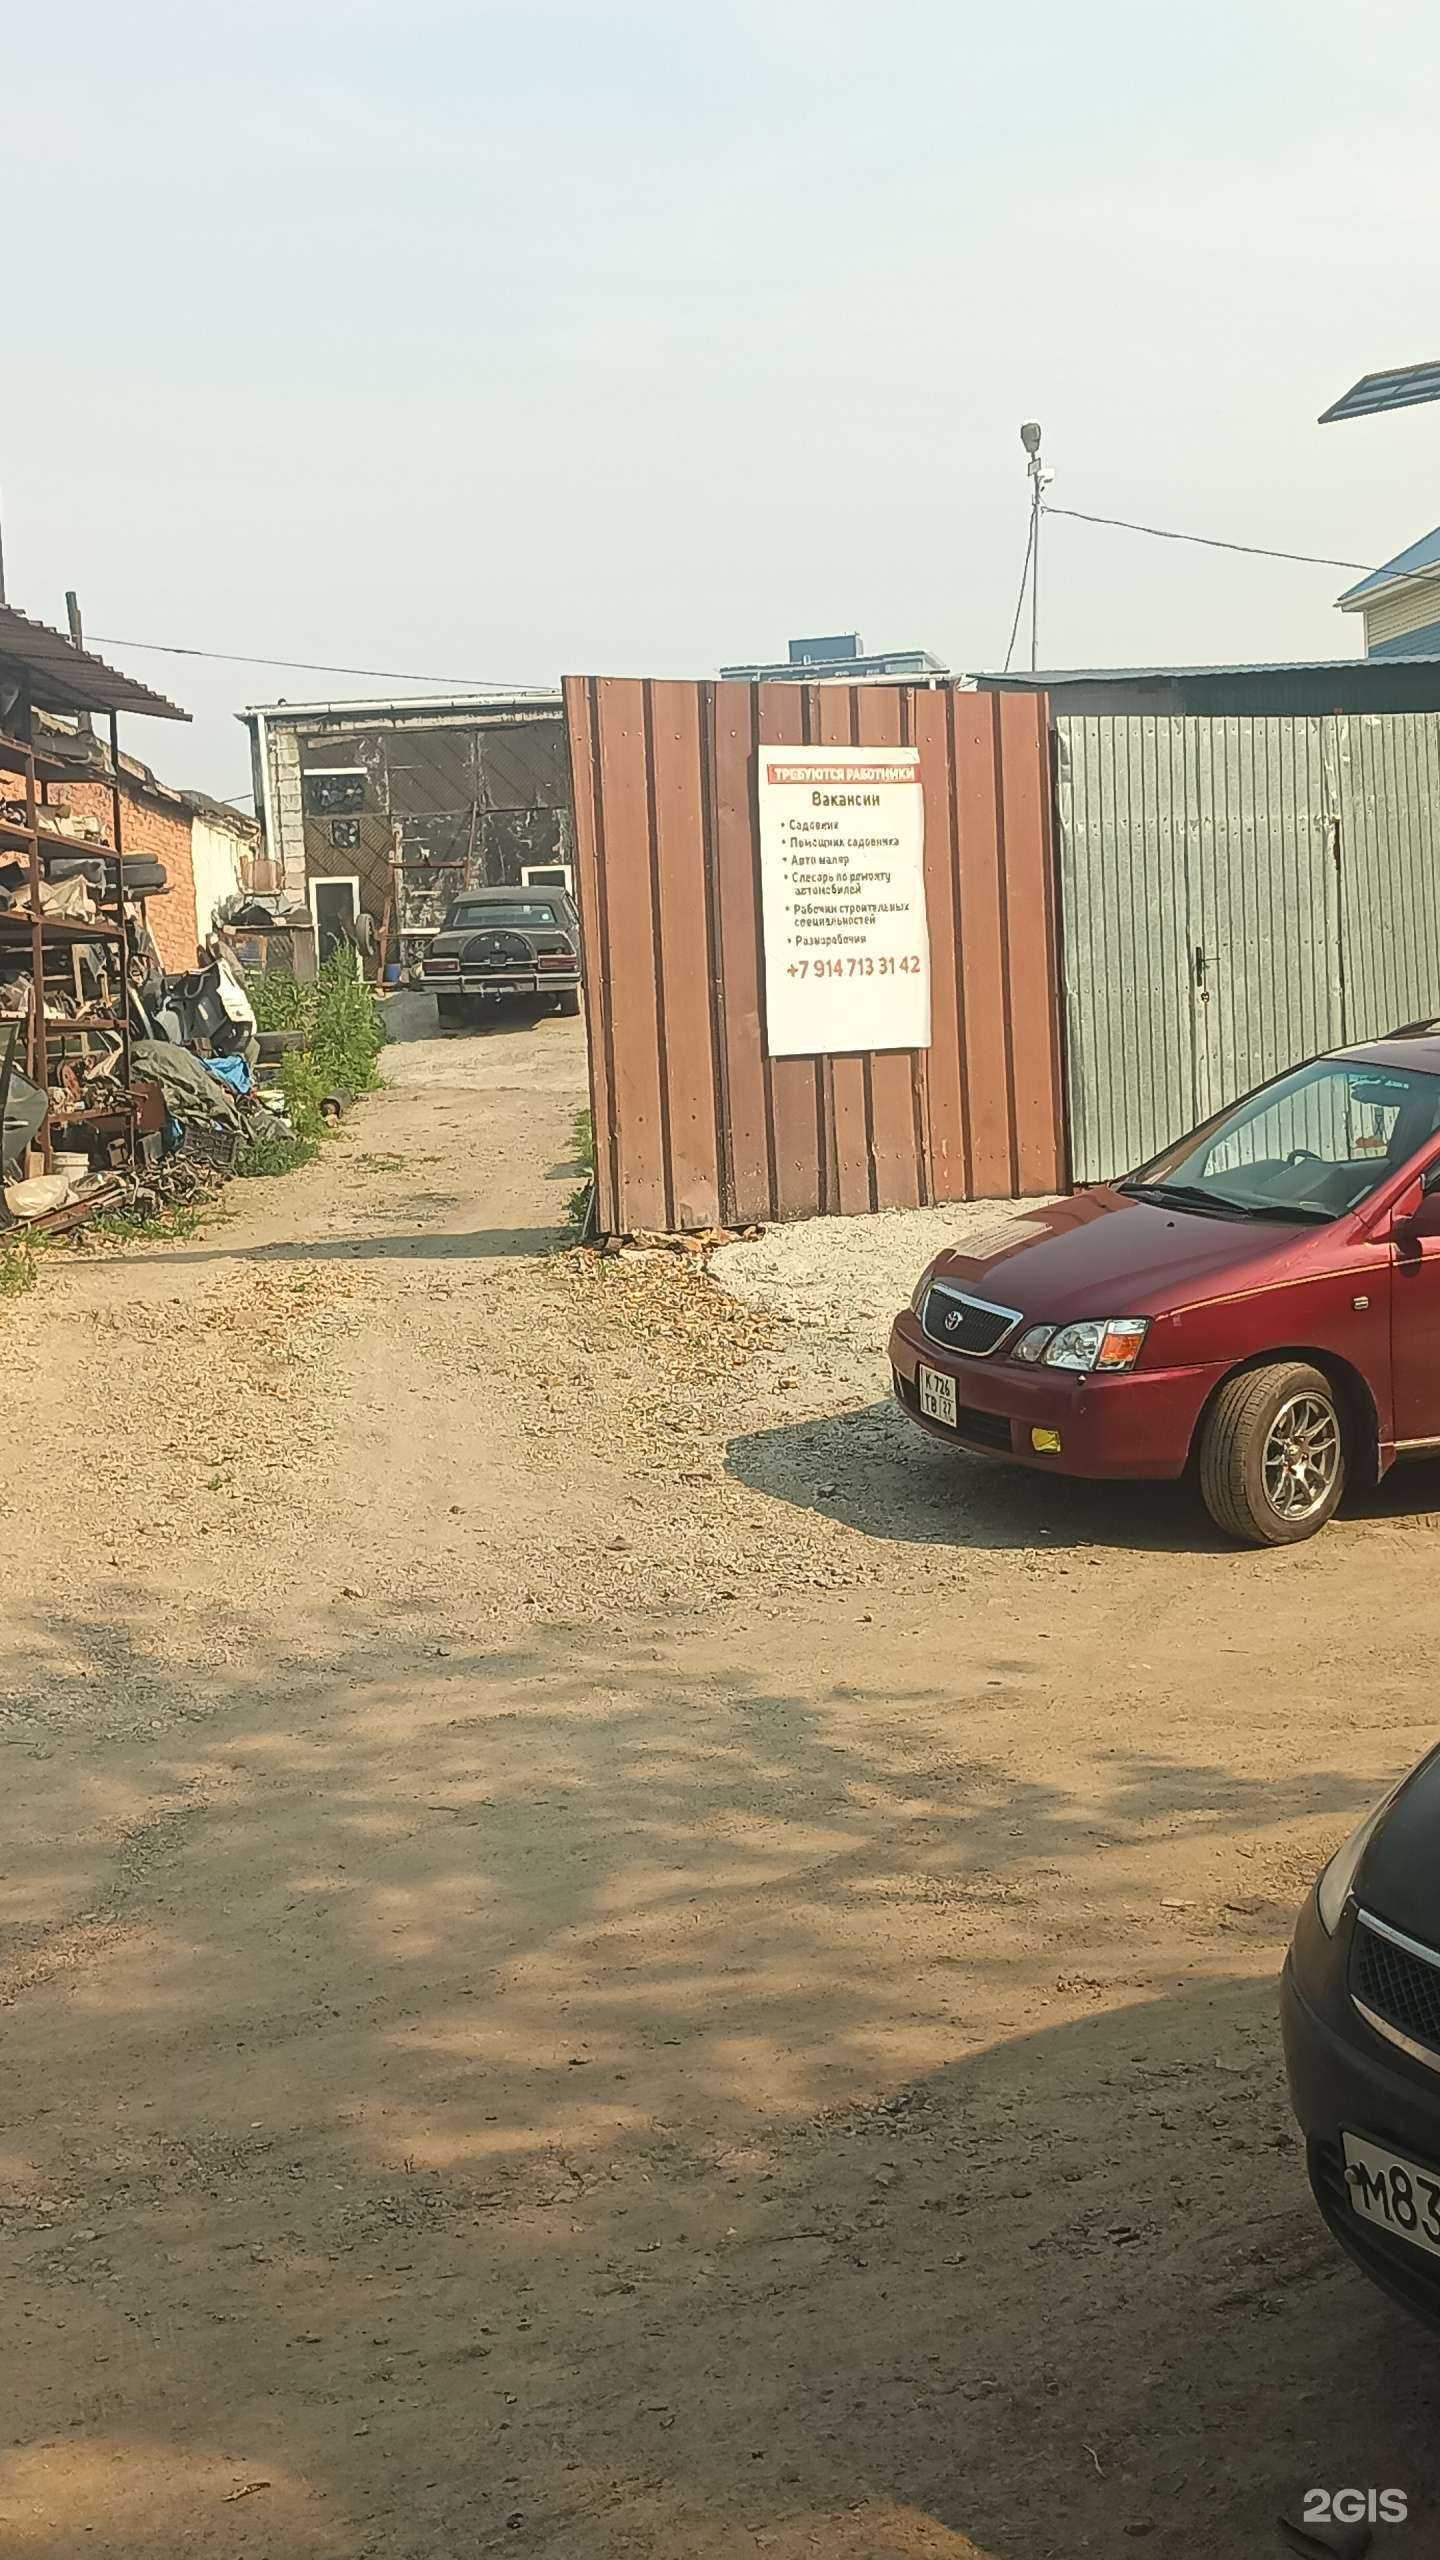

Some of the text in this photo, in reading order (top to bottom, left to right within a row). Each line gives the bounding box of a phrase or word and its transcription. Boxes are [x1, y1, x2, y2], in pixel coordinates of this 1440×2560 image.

[774, 767, 915, 781] ТРЕБУЮТСЯ РАБОТНИКИ
[812, 790, 881, 807] Вакансии
[789, 819, 839, 832] Садовник
[790, 836, 900, 849] Помощник садовника
[791, 854, 850, 867] Авто маляр
[792, 872, 891, 884] Слесарь по ремонту
[795, 883, 862, 896] автомобилей
[839, 902, 910, 915] строительных
[794, 913, 877, 928] специальностей
[786, 955, 921, 979] +7 914 713 31 42
